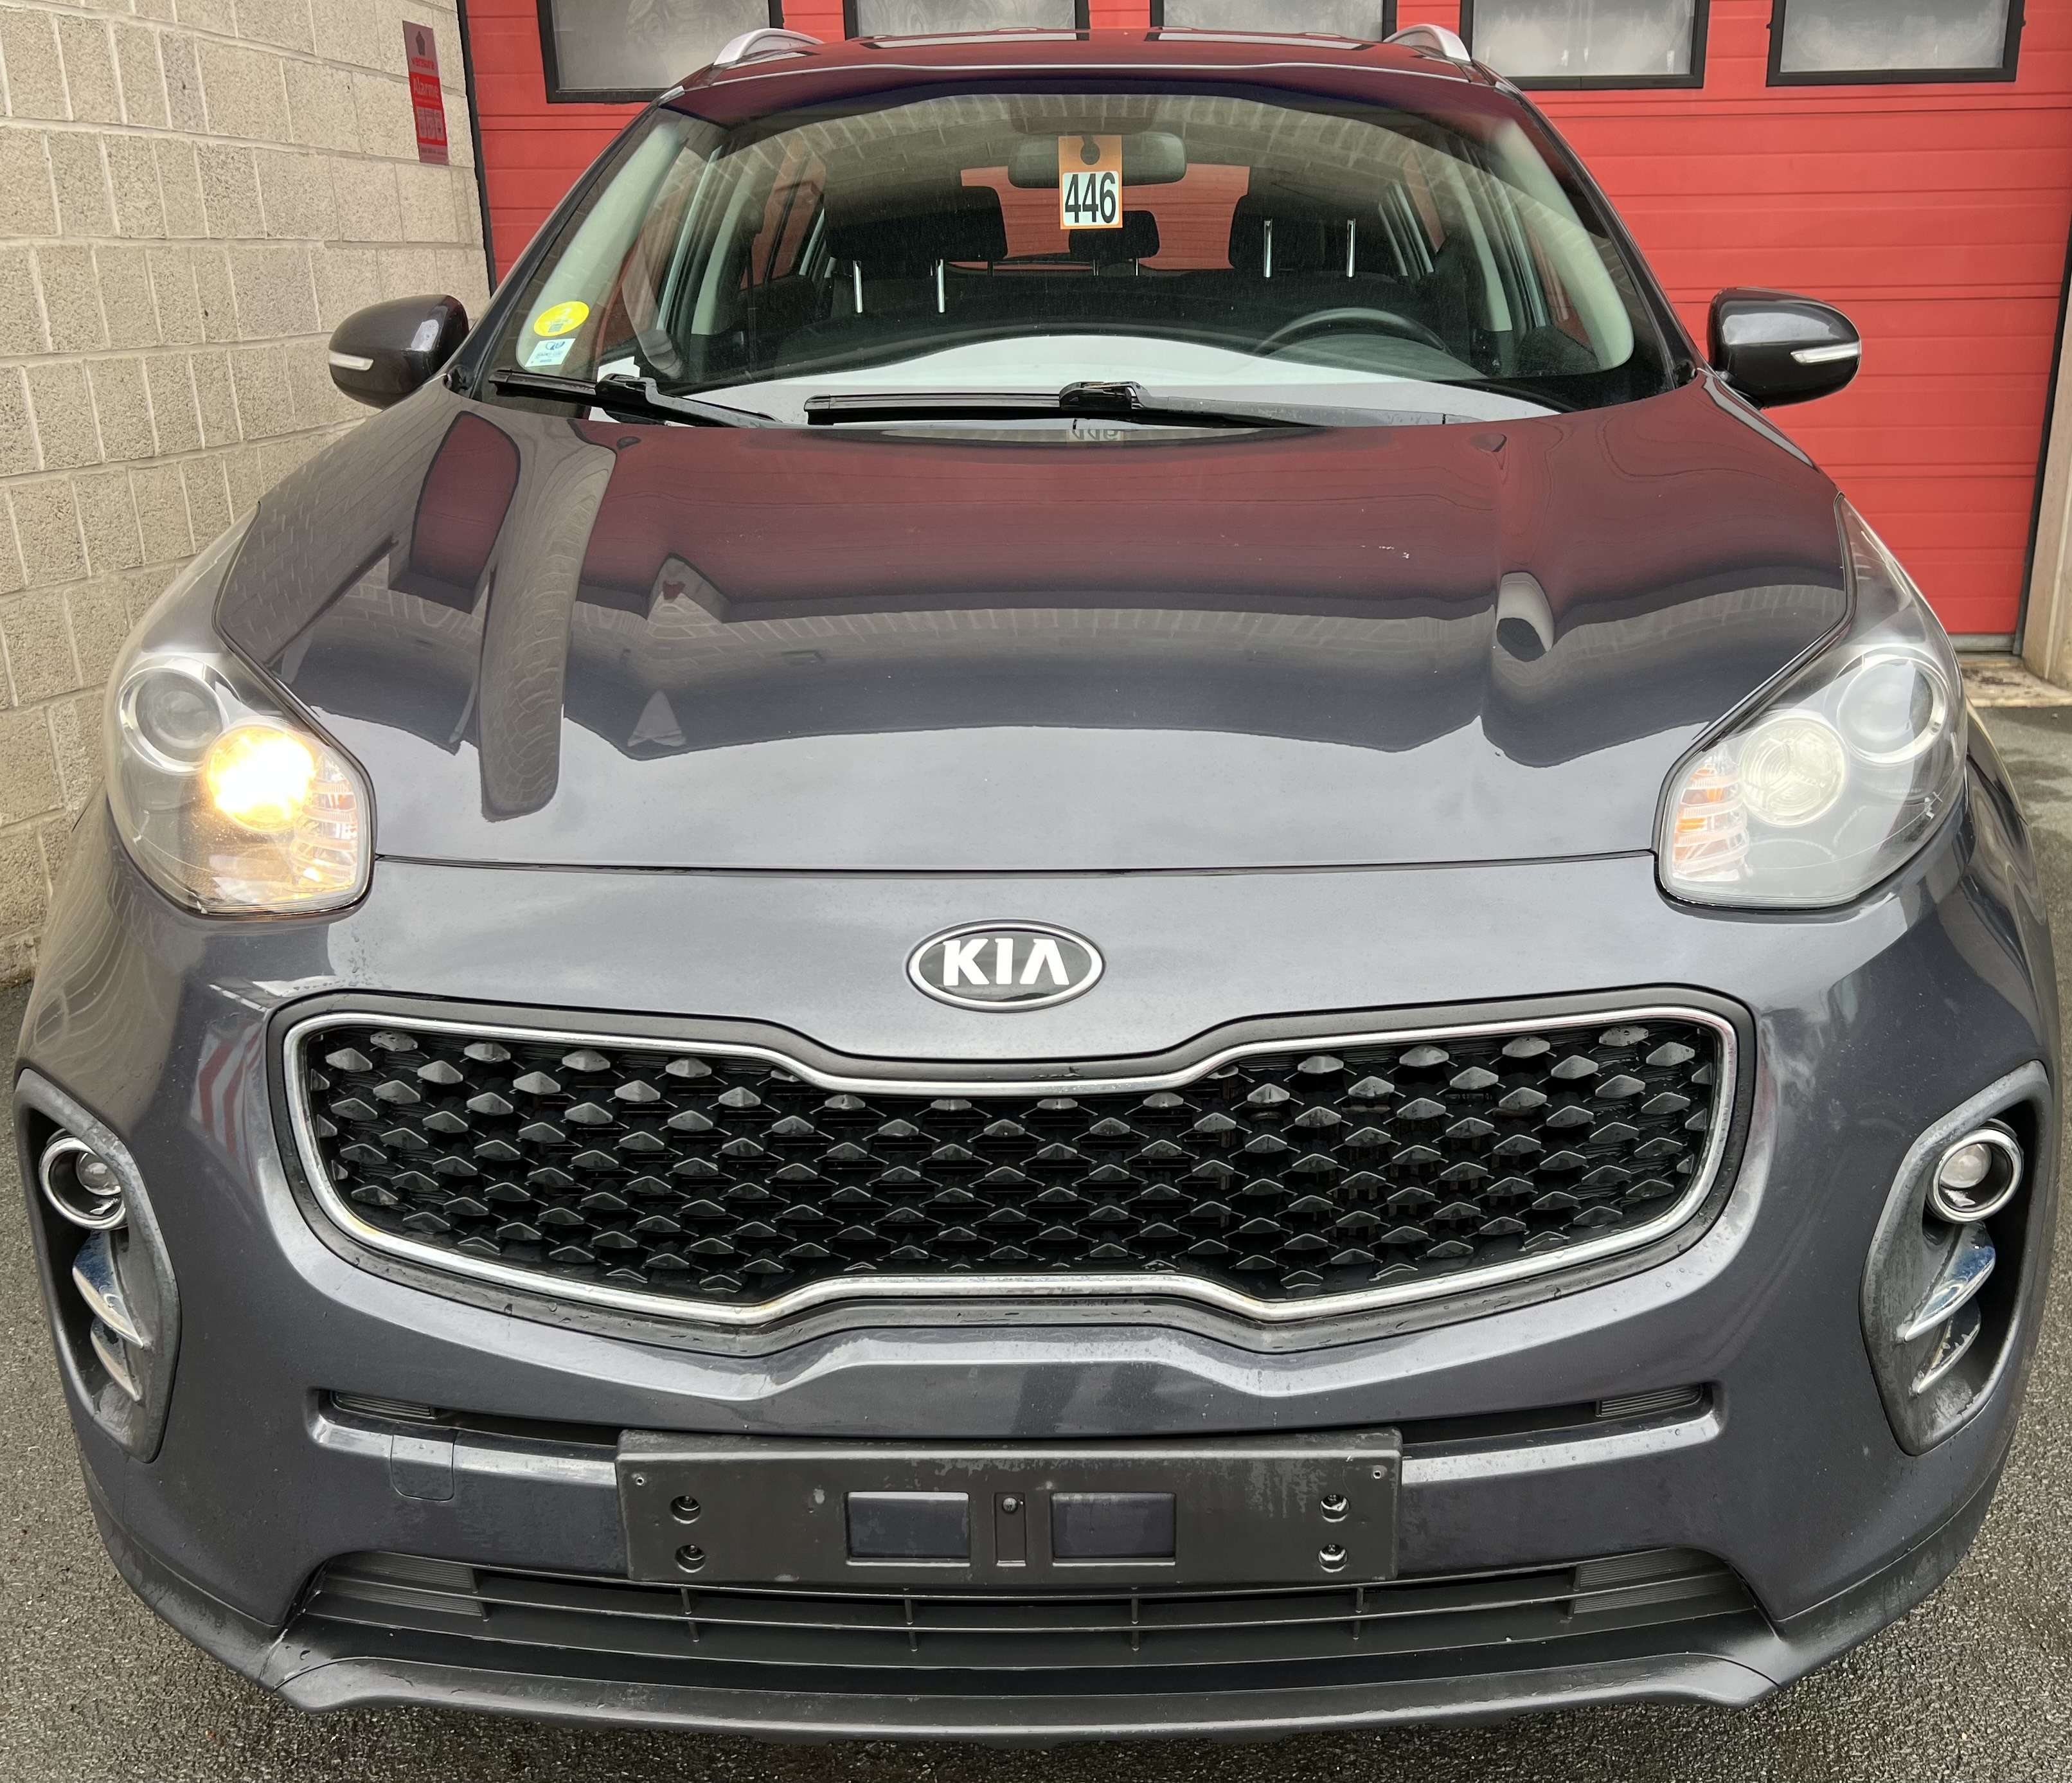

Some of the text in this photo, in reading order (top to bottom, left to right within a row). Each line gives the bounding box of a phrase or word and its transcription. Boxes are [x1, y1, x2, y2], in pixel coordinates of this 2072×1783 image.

[413, 76, 439, 99] Alarme
[1065, 172, 1116, 224] 446
[943, 937, 1069, 987] KIA
